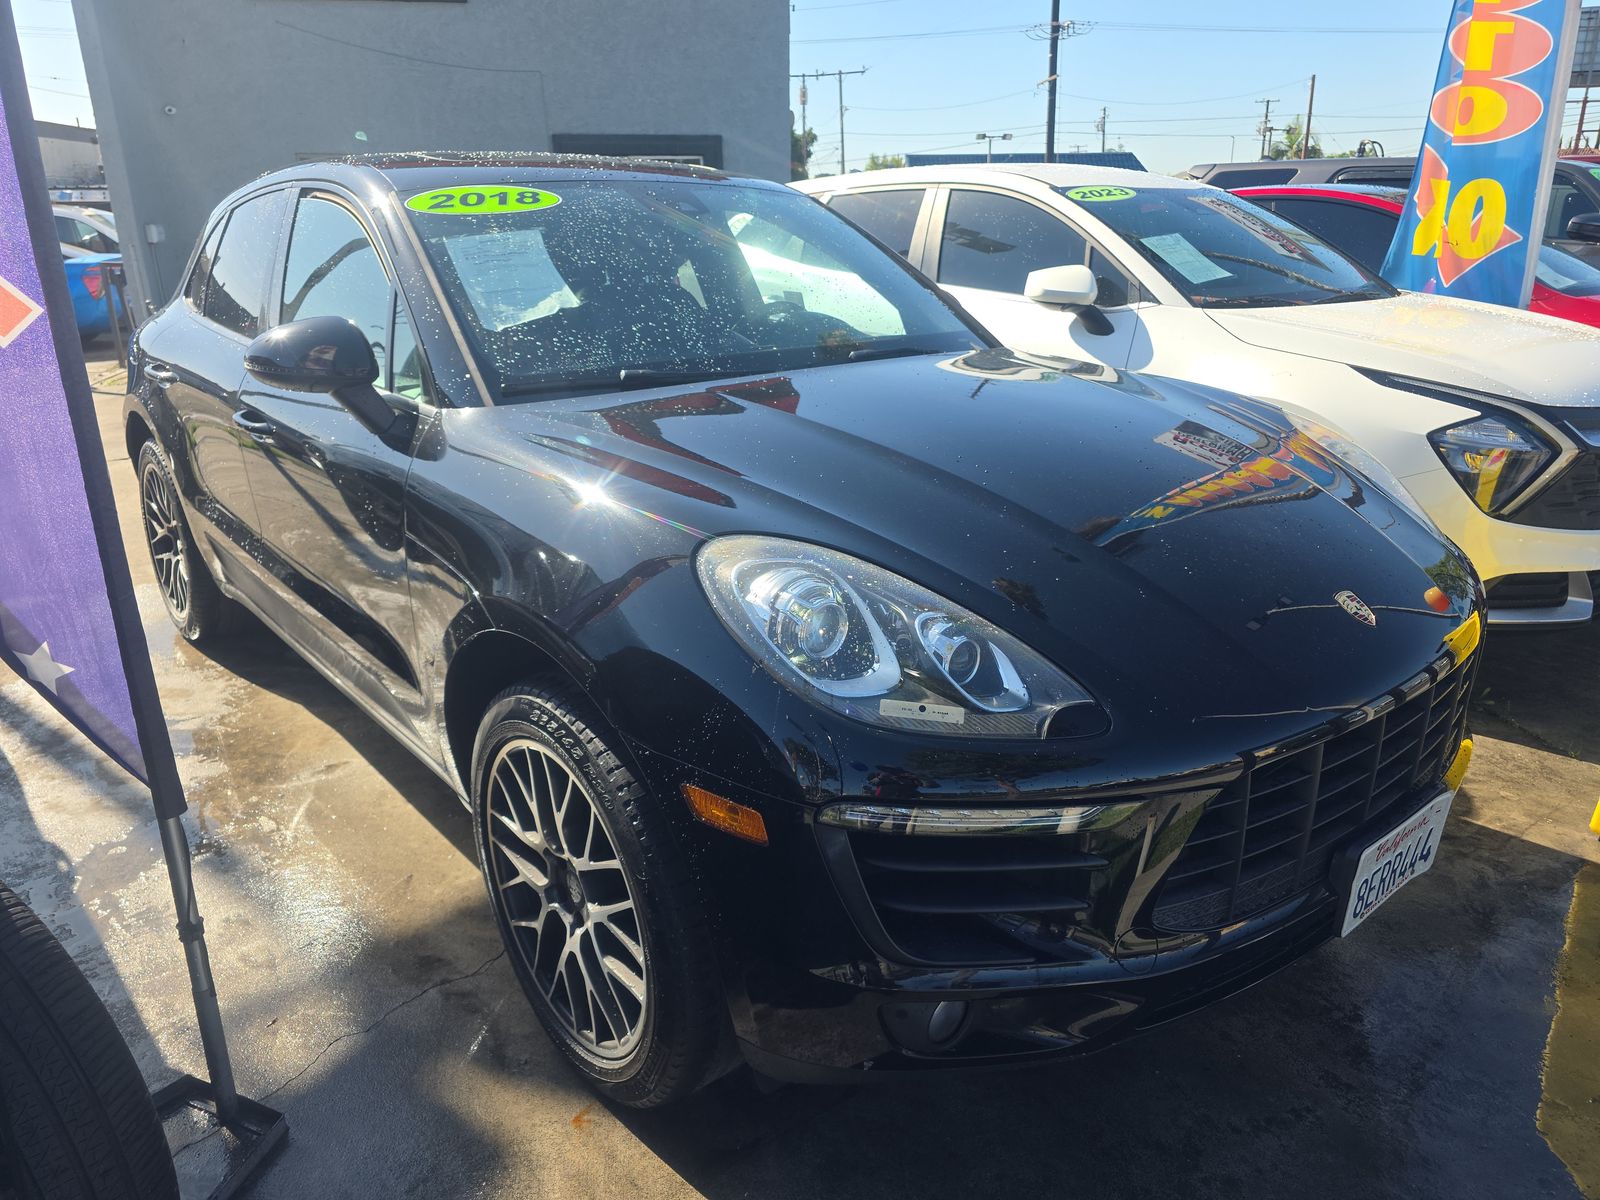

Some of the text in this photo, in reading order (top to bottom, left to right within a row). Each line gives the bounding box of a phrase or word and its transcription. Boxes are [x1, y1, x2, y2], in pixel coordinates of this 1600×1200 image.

[427, 191, 541, 210] 2018
[1075, 187, 1130, 200] 2023
[1352, 827, 1434, 919] 8ERR444
